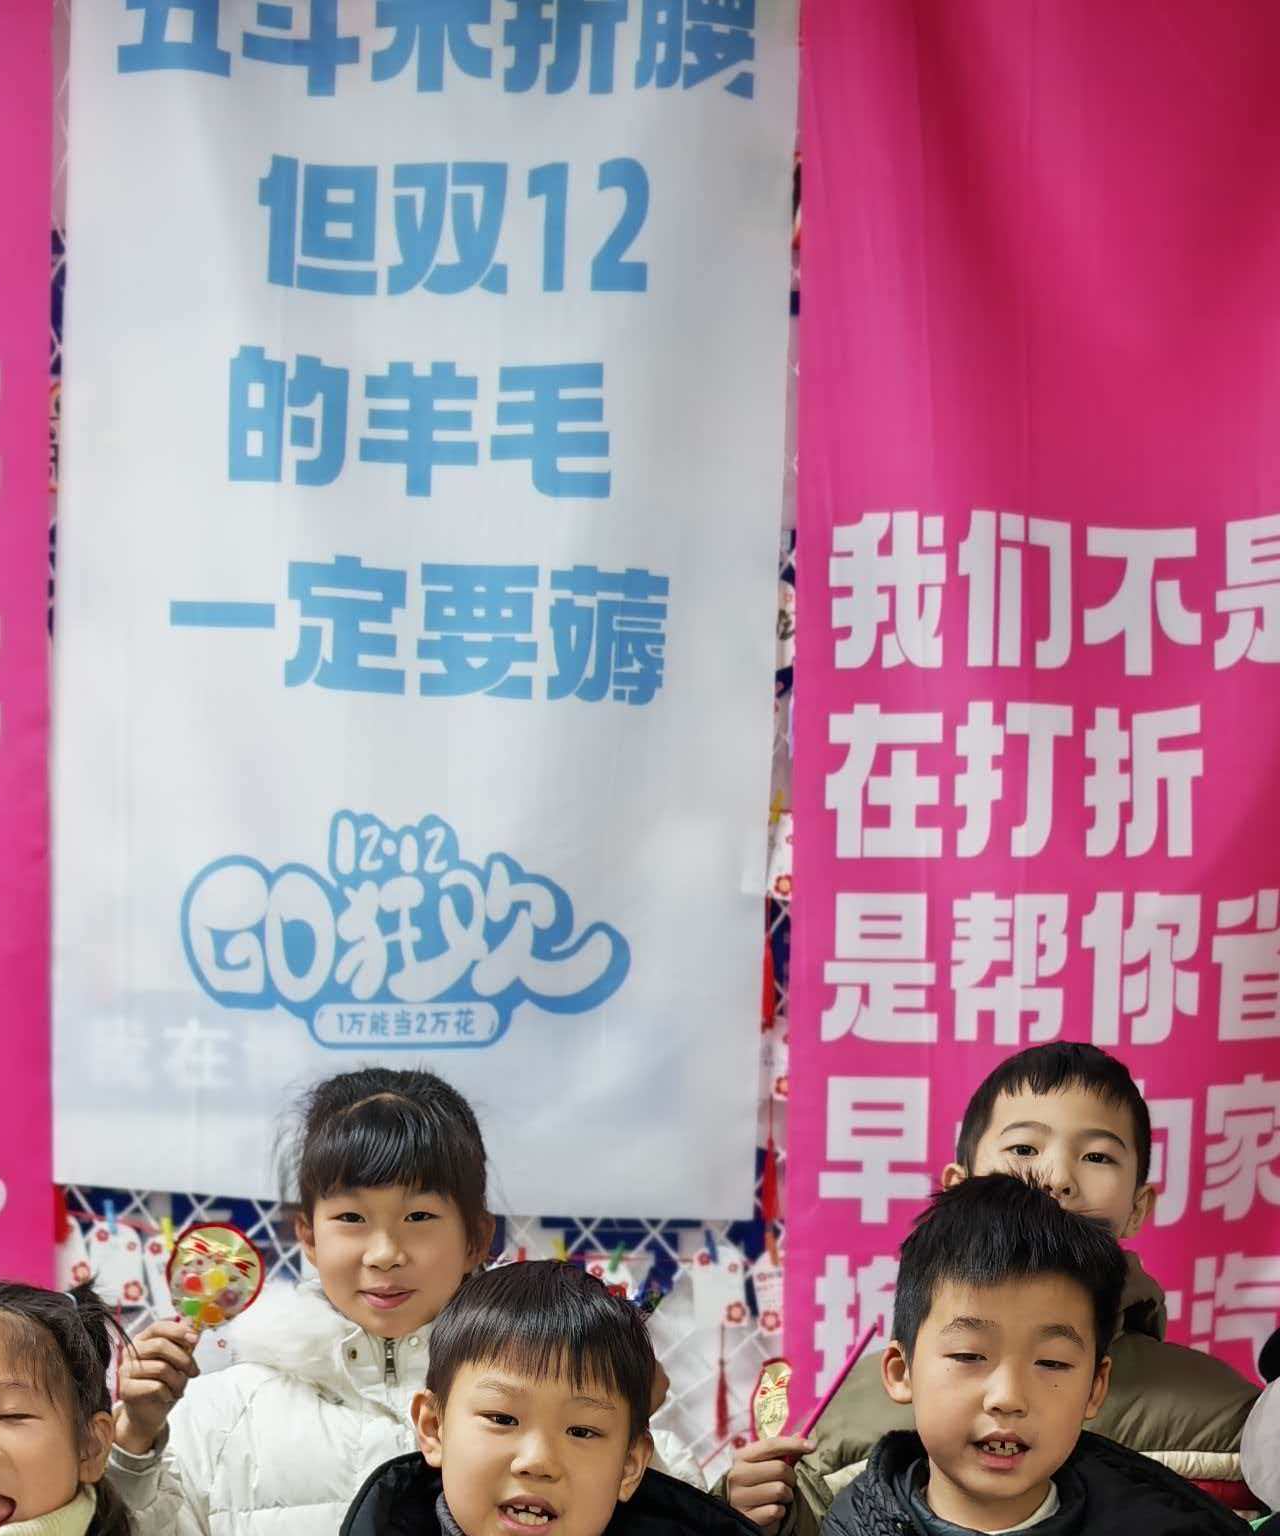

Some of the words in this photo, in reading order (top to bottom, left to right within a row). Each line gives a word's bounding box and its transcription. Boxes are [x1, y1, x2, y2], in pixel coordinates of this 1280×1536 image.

[258, 153, 650, 297] 但双12
[228, 345, 612, 499] 的羊毛
[169, 555, 670, 707] 一定要薅
[825, 701, 1203, 858] 在打折
[335, 1009, 477, 1037] 1万能当2万花
